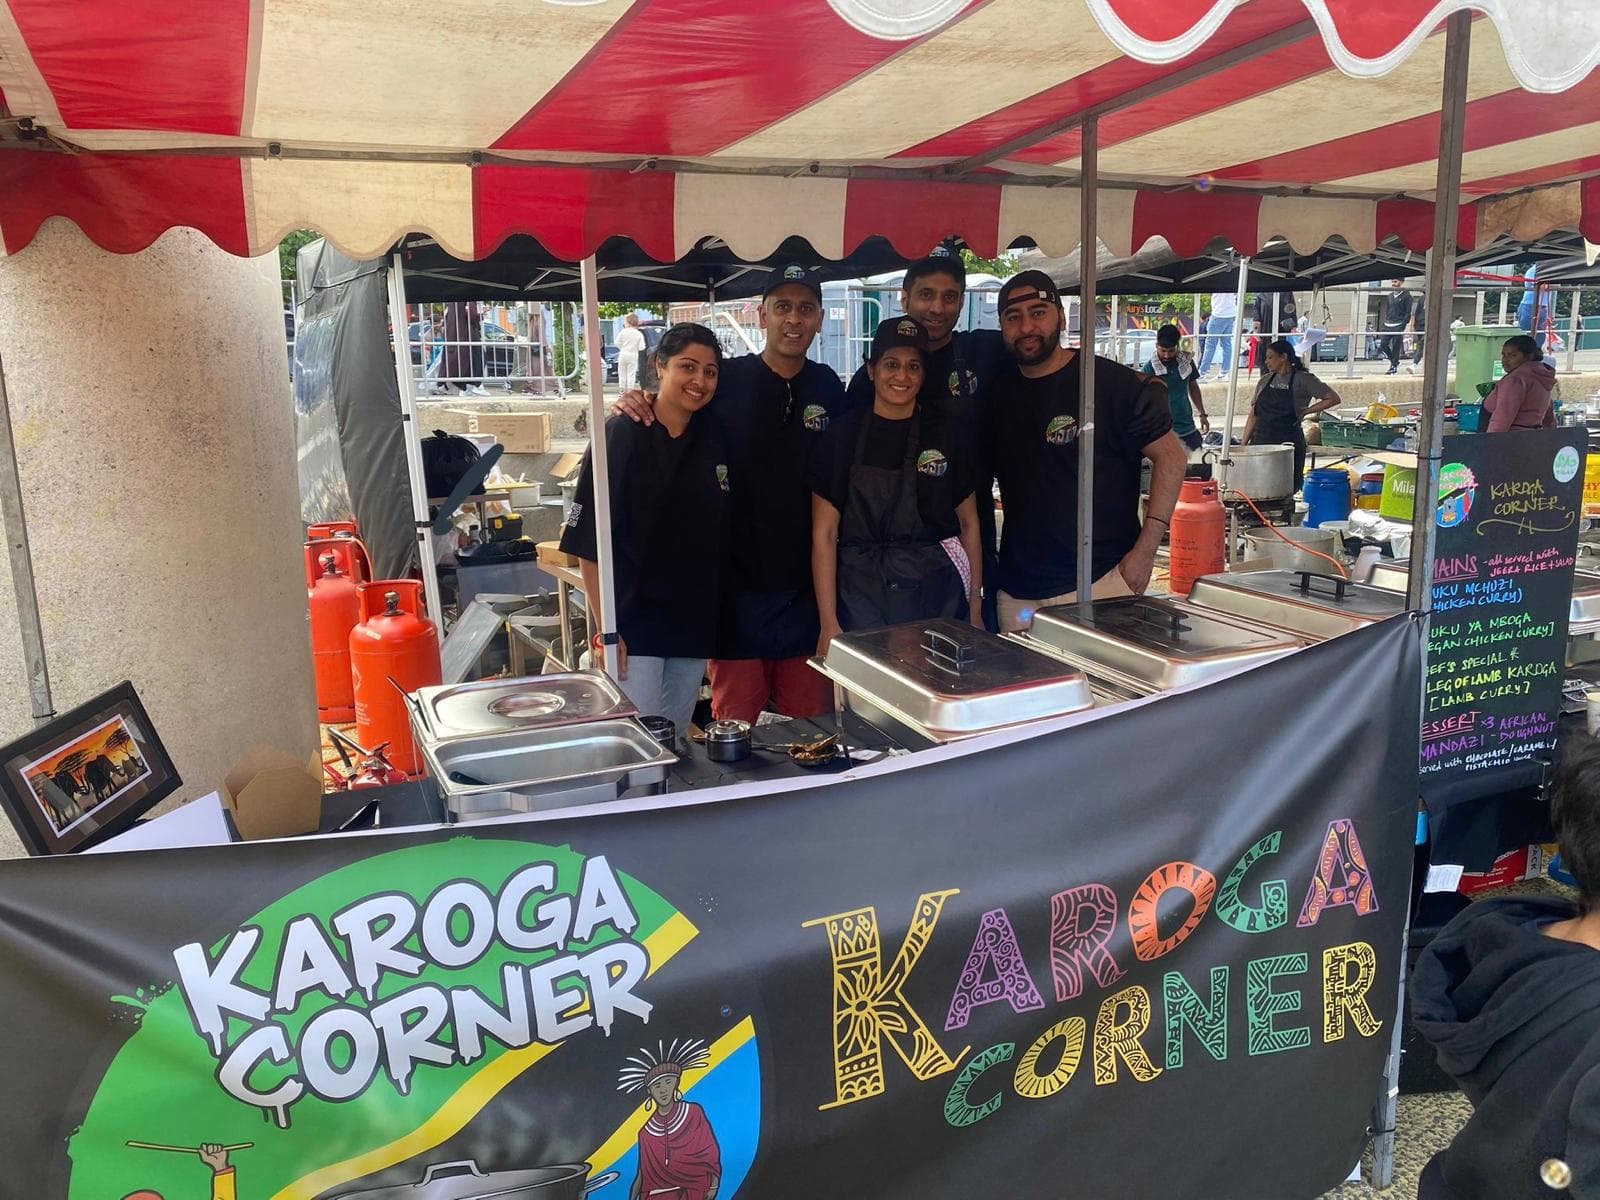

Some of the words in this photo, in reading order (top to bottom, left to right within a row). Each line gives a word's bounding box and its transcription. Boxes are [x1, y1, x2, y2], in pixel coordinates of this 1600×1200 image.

[1490, 479, 1544, 502] KAROGA
[1494, 496, 1565, 515] CORNER
[1433, 553, 1478, 578] AINS
[1536, 547, 1559, 560] with
[1490, 565, 1520, 577] JEERA
[1431, 584, 1458, 599] UKU
[1465, 578, 1513, 595] MCHUZI
[1433, 596, 1475, 613] HICKEN
[1427, 639, 1460, 655] EGAN
[1464, 630, 1514, 647] CHICKEN
[1516, 621, 1555, 638] CURRY]
[1430, 624, 1460, 639] UKU
[1468, 620, 1482, 635] YA
[1489, 612, 1532, 629] MBOGA
[1461, 652, 1508, 670] SPECIAL
[1426, 680, 1452, 694] LEG
[1454, 675, 1470, 689] OF
[1470, 669, 1502, 685] LAMB
[1507, 661, 1557, 680] KAROGA
[1422, 711, 1482, 734] ESSERT
[1499, 712, 1546, 730] AFRICAN
[1420, 734, 1485, 761] MANDAZI
[1498, 721, 1556, 744] DOUGHNUT
[1444, 756, 1462, 768] with
[173, 855, 638, 1056] KAROGA
[802, 818, 1380, 1111] KAROGA
[218, 942, 654, 1129] CORNER
[943, 940, 1384, 1128] CORNER
